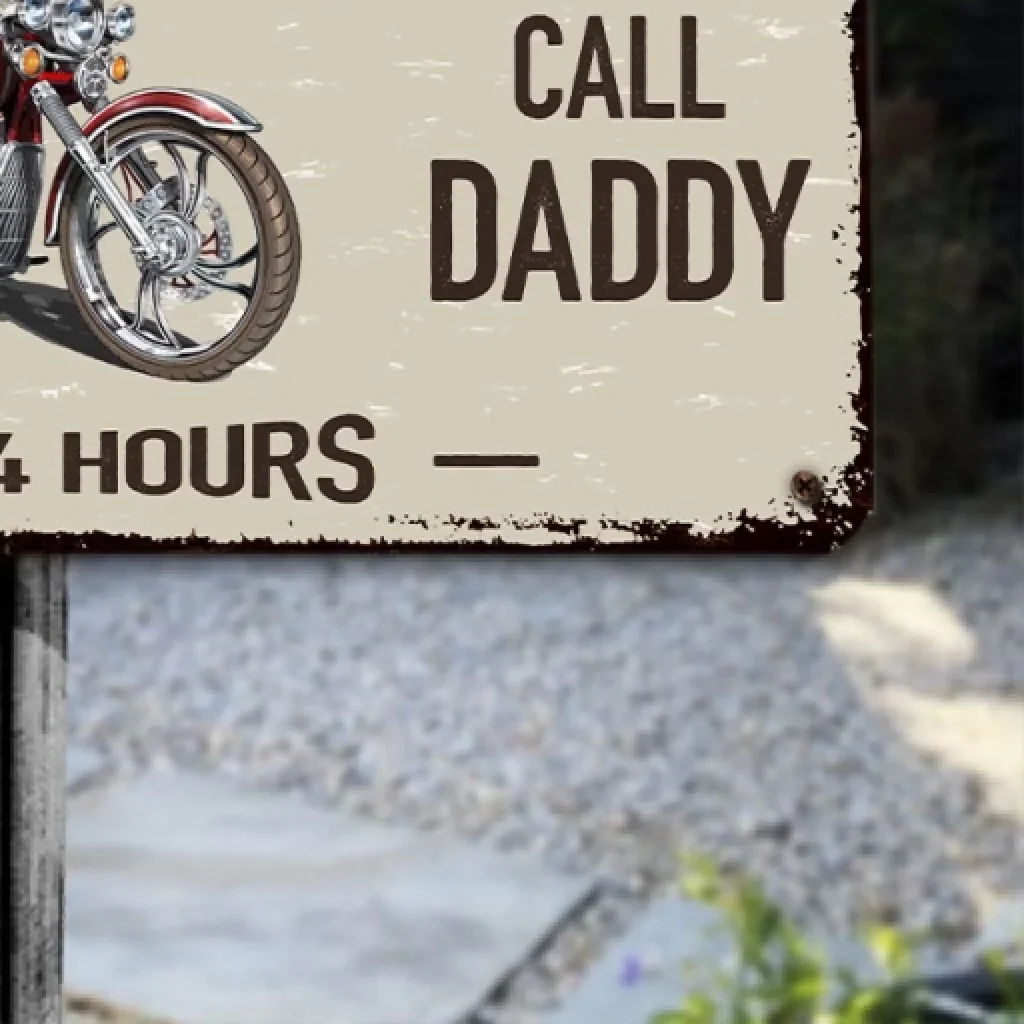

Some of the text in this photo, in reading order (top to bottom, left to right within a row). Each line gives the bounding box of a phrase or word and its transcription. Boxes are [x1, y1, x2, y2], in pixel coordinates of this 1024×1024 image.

[514, 14, 727, 120] CALL
[429, 159, 812, 304] DADDY
[62, 412, 376, 506] HOURS
